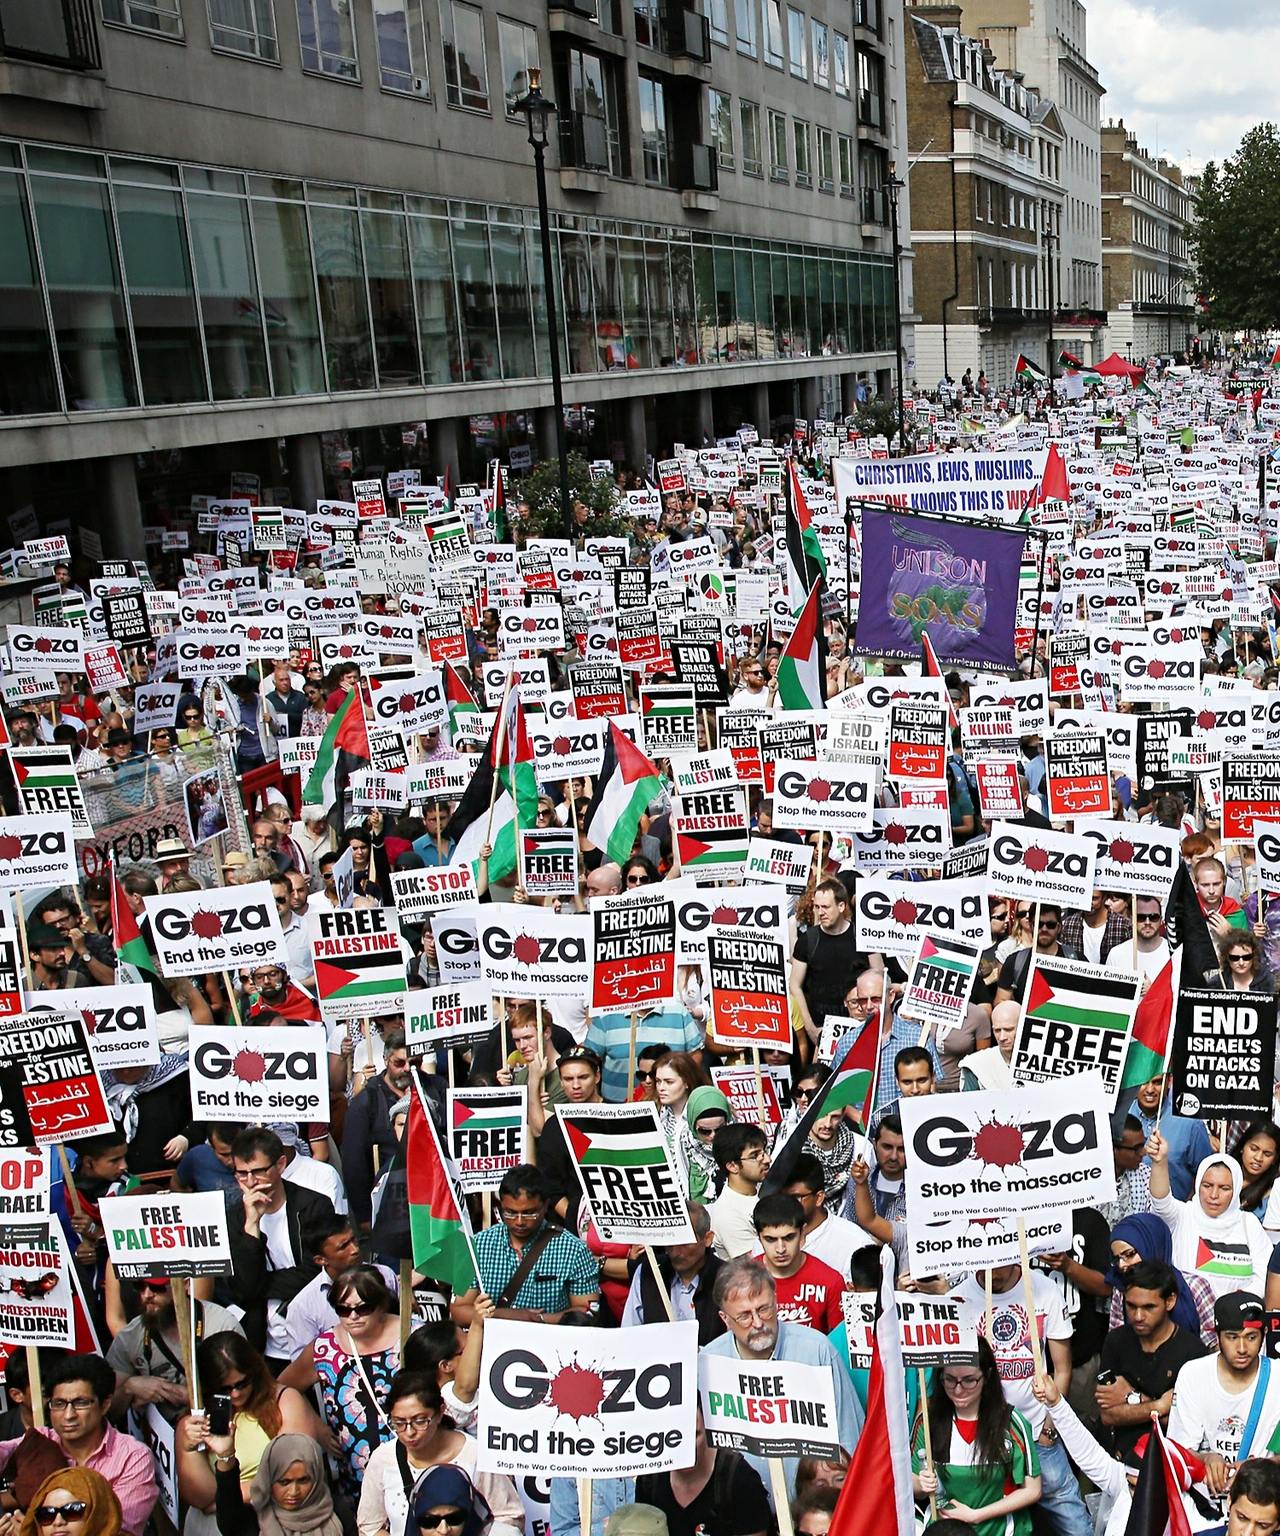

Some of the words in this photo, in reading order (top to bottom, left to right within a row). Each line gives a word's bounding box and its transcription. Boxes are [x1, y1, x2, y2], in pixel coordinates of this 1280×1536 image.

[855, 462, 934, 486] CHRISTIANS,
[937, 461, 972, 483] JEWS,
[975, 459, 1042, 480] MUSLIMS...
[911, 491, 957, 512] KNOWS
[960, 491, 988, 511] THIS
[992, 491, 1004, 510] IS
[27, 542, 42, 553] UK:
[44, 540, 66, 552] STOP
[354, 548, 385, 560] Human
[389, 547, 423, 561] Rights
[384, 559, 397, 568] For
[892, 546, 987, 585] UNISON
[360, 569, 379, 581] The
[378, 569, 425, 582] Palestinians
[1185, 584, 1215, 592] KILLING
[110, 598, 139, 612] END
[891, 593, 982, 629] SOAS
[112, 619, 144, 630] ATTACKS
[90, 651, 108, 660] STOP
[856, 647, 883, 656] School
[886, 648, 894, 656] of
[18, 677, 36, 685] FREE
[841, 722, 872, 738] END
[833, 736, 878, 750] ISRAELI
[828, 753, 881, 766] APARTHEID
[985, 765, 1009, 776] STOP
[982, 776, 1013, 787] ISRAELI
[987, 788, 1012, 798] STATE
[985, 798, 1018, 810] TERROR
[858, 850, 881, 862] End
[885, 850, 905, 861] the
[910, 849, 943, 863] siege
[396, 880, 425, 896] UK:
[428, 870, 471, 891] STOP
[399, 895, 439, 910] ARMING
[441, 891, 476, 904] ISRAEL
[605, 898, 639, 909] Socialist
[640, 894, 664, 906] Worker
[319, 909, 388, 937] FREE
[601, 905, 669, 931] FREEDOM
[629, 928, 641, 938] for
[314, 933, 398, 956] PALESTINE
[596, 932, 673, 961] PALESTINE
[486, 969, 509, 983] Stop
[511, 972, 528, 982] the
[531, 972, 588, 983] massacre
[601, 959, 665, 985] لفلسطين
[612, 979, 661, 998] الحرية
[1180, 989, 1208, 999] Palestine
[1210, 991, 1239, 1002] Solidarity
[1242, 993, 1274, 1002] Campaign
[432, 994, 461, 1009] FREE
[410, 1005, 488, 1032] PALESTINE
[1193, 1006, 1258, 1035] END
[1018, 1019, 1126, 1066] FREE
[1187, 1037, 1262, 1054] ISRAEL'S
[1186, 1056, 1260, 1071] ATTACKS
[1186, 1073, 1209, 1088] ON
[1214, 1074, 1259, 1091] GAZA
[198, 1092, 230, 1106] End
[235, 1092, 262, 1107] the
[269, 1093, 319, 1111] siege
[1183, 1099, 1198, 1109] PSC
[560, 1109, 588, 1117] Palestine
[589, 1109, 616, 1118] Solidarity
[617, 1108, 651, 1116] Campaign
[580, 1166, 678, 1200] FREE
[920, 1180, 965, 1199] Stop
[971, 1176, 1001, 1193] the
[1007, 1166, 1102, 1193] massacre
[141, 1205, 182, 1225] FREE
[591, 1200, 683, 1217] PALESTINE
[933, 1208, 949, 1217] Stop
[612, 1219, 638, 1227] ISRAELI
[640, 1218, 685, 1227] OCCUPATION
[113, 1225, 220, 1250] PALESTINE
[794, 1285, 825, 1302] JPN
[738, 1374, 785, 1397] FREE
[709, 1391, 828, 1428] PALESTINE
[487, 1426, 538, 1449] End
[547, 1430, 594, 1455] the
[603, 1428, 683, 1457] siege
[712, 1432, 732, 1448] FOA
[497, 1461, 514, 1469] Stop
[516, 1462, 529, 1470] the
[550, 1464, 587, 1472] Coalition
